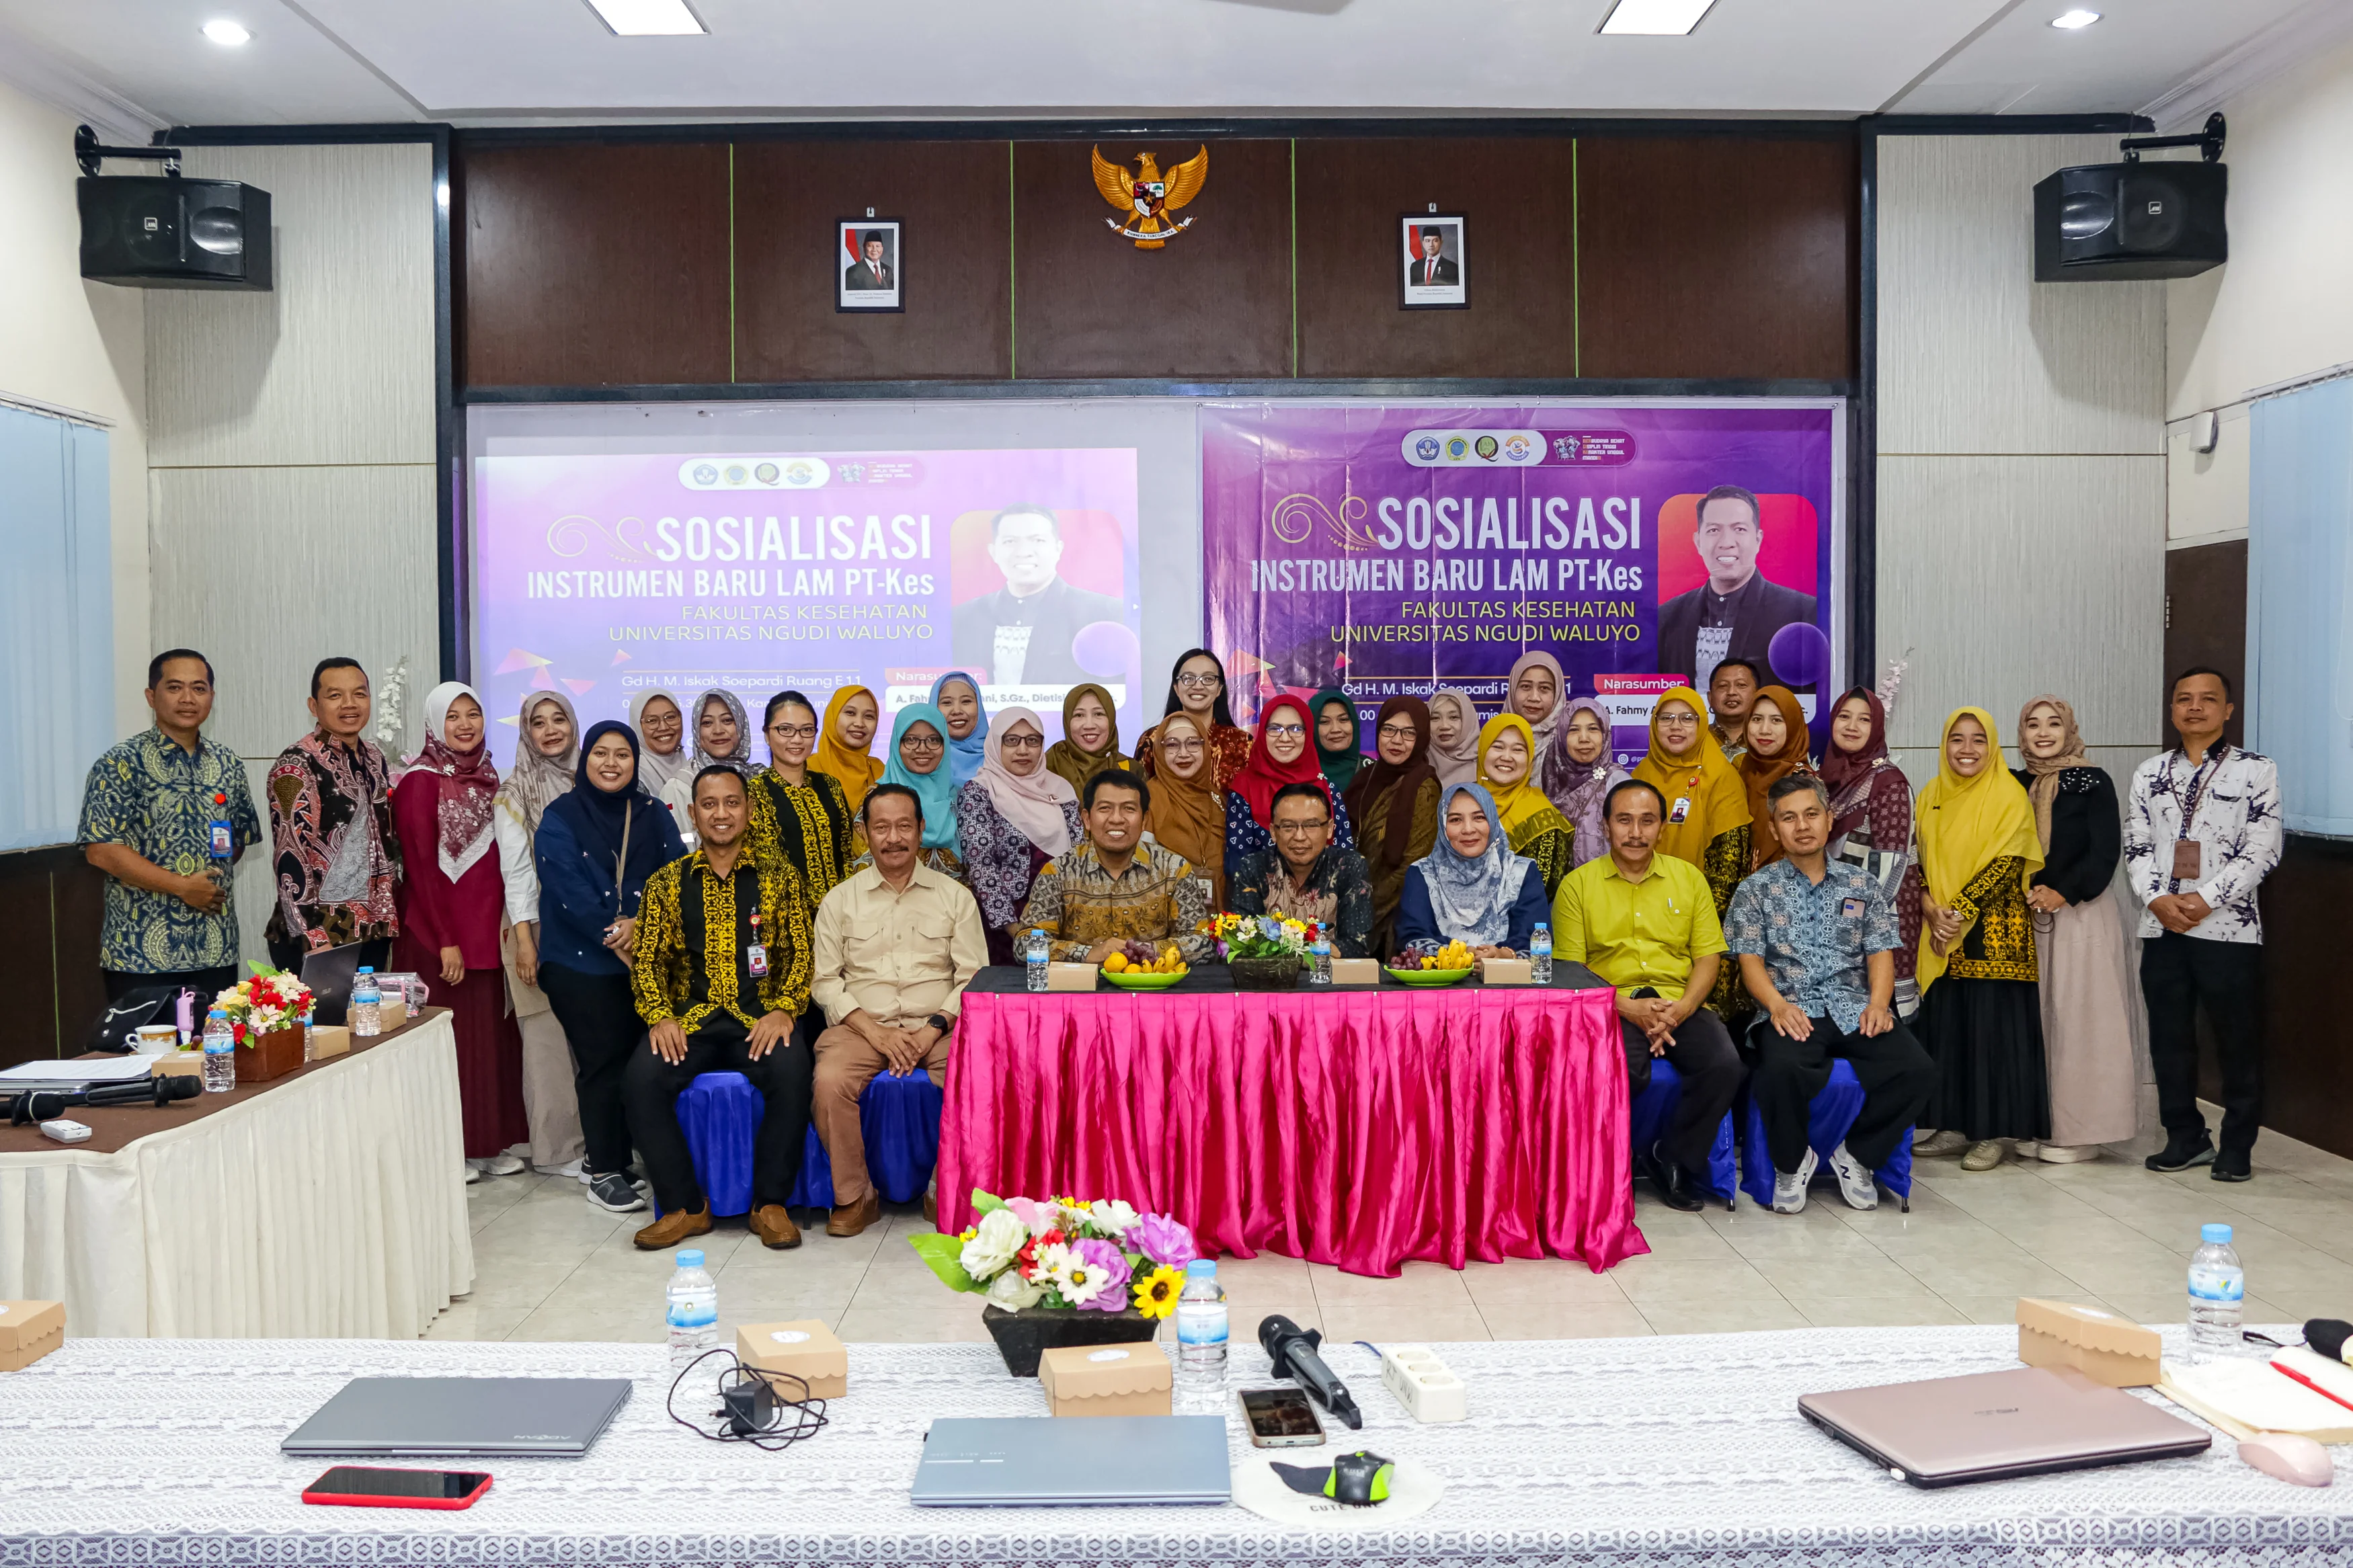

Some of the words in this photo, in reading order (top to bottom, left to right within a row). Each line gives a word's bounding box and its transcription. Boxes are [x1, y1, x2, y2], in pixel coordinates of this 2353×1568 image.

[1378, 497, 1640, 550] SOSIALISASI
[655, 515, 931, 563] SOSIALISASI
[1251, 559, 1405, 591] INSTRUMEN
[1414, 559, 1482, 591] BARU
[1494, 559, 1547, 591] LAM
[1558, 559, 1642, 591] PT-Kes
[527, 570, 683, 599] INSTRUMEN
[694, 570, 767, 597] BARU
[776, 569, 834, 597] LAM
[844, 569, 934, 595] PT-Kes
[682, 606, 790, 620] FAKULTAS
[797, 604, 927, 620] KESEHATAN
[1402, 602, 1506, 618] FAKULTAS
[1512, 601, 1635, 618] KESEHATAN
[609, 626, 753, 642] UNIVERSITAS
[758, 624, 831, 641] NGUDI
[836, 624, 933, 640] WALUYO
[1331, 625, 1468, 643] UNIVERSITAS
[1475, 624, 1544, 642] NGUDI
[1549, 624, 1640, 642] WALUYO
[622, 675, 643, 686] Gd
[645, 676, 660, 686] H.
[664, 676, 680, 686] M.
[684, 675, 719, 686] Iskak
[721, 675, 783, 689] Soepardi
[787, 675, 832, 688] Ruang
[1342, 683, 1362, 695] Gd
[1365, 683, 1380, 695] H.
[1383, 683, 1398, 695] M.
[1402, 682, 1435, 695] Iskak
[896, 695, 907, 703] A.
[1616, 706, 1648, 716] Fahmy
